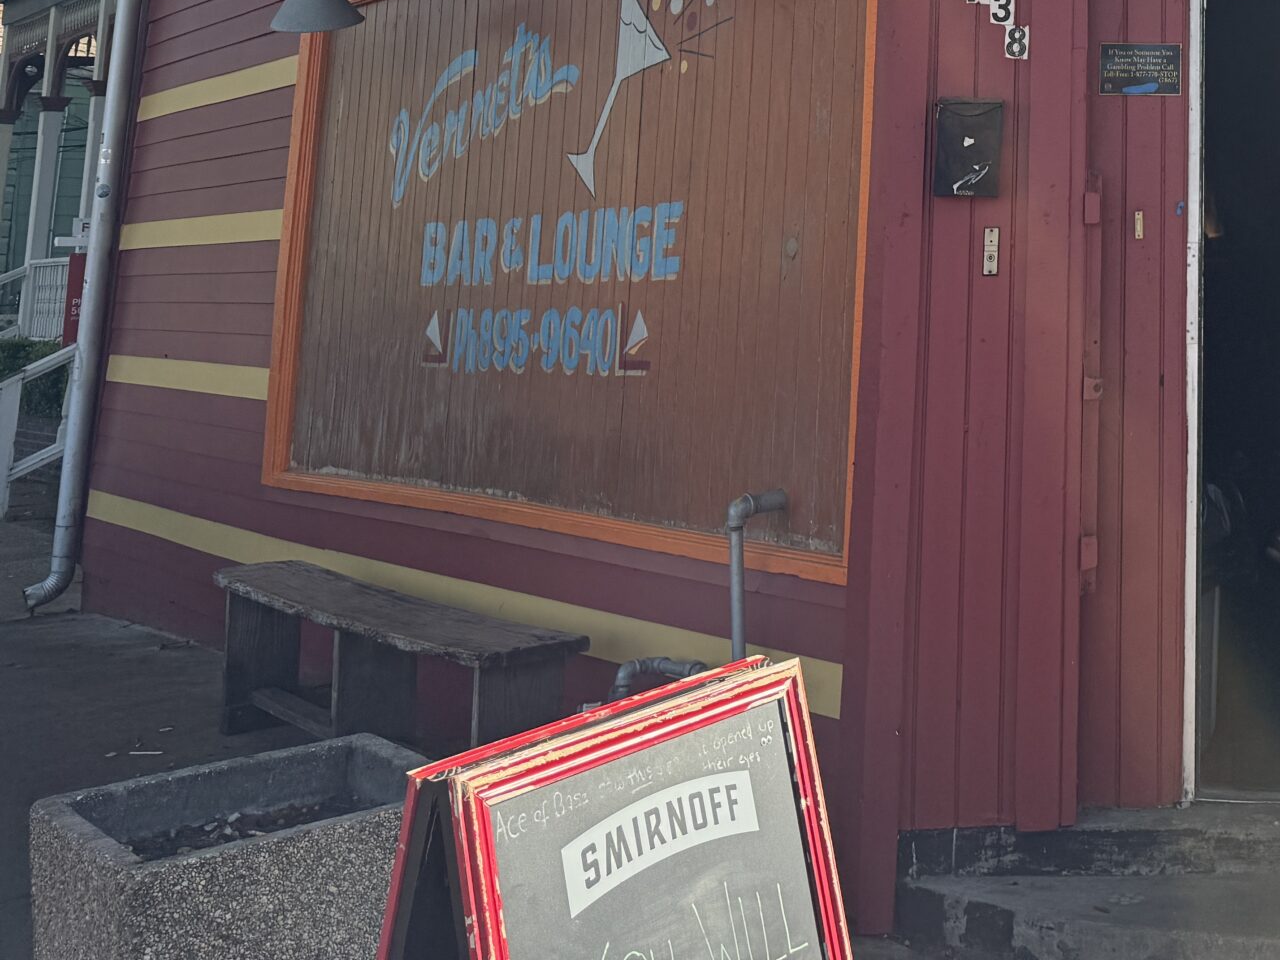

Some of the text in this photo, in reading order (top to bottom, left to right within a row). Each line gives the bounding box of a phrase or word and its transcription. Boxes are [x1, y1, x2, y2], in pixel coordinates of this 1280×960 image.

[420, 217, 498, 286] BAR
[526, 201, 685, 285] LOUNGE
[497, 809, 528, 843] Ace
[533, 799, 550, 828] of
[713, 721, 753, 755] opened
[758, 719, 774, 734] up
[702, 751, 760, 772] their eyes
[580, 783, 739, 890] SMIRNOFF
